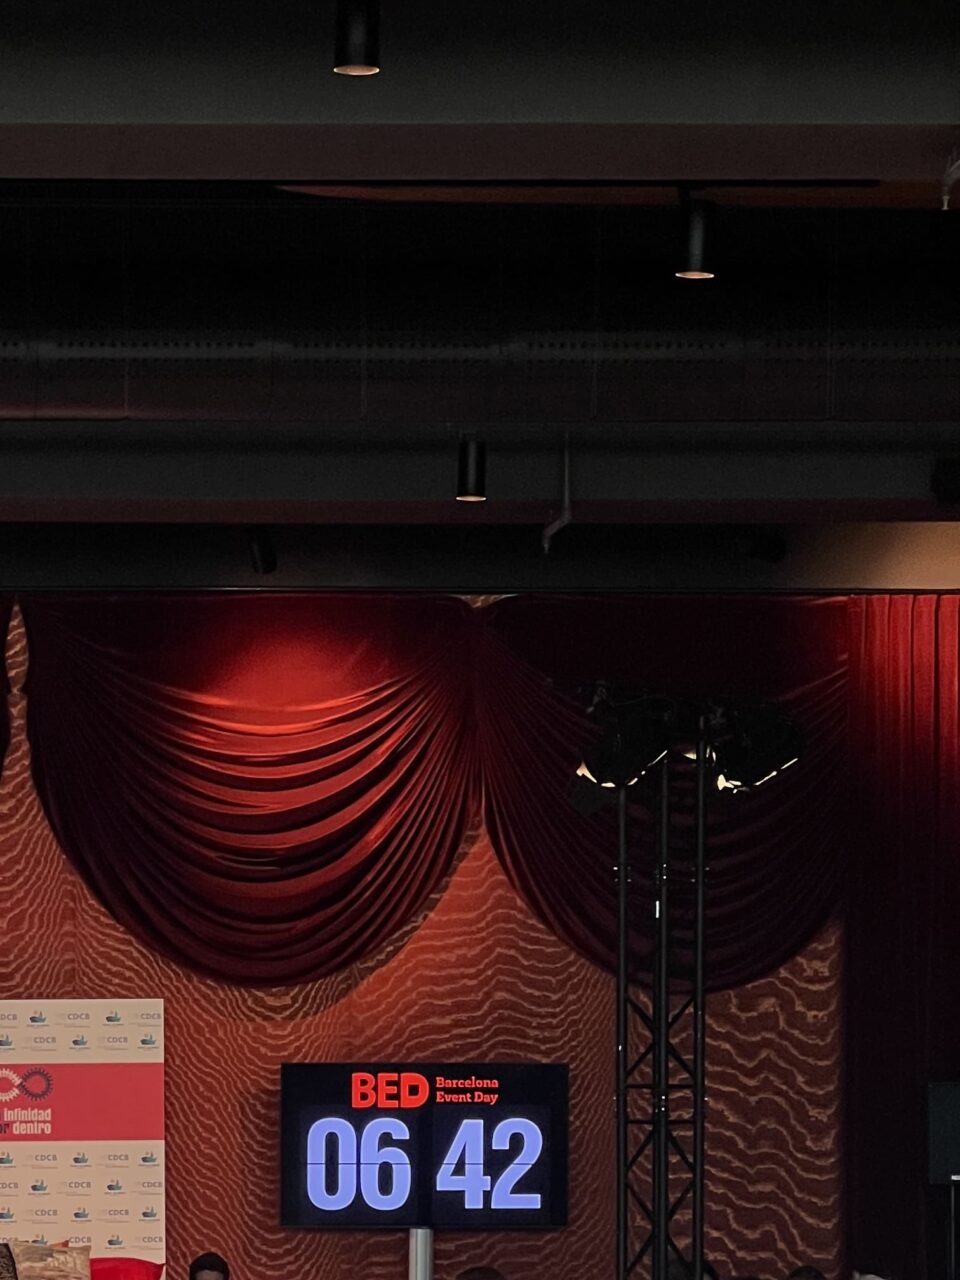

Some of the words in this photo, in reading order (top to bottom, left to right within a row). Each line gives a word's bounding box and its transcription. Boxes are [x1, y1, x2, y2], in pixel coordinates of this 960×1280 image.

[435, 1076, 499, 1088] Barcelona
[351, 1072, 430, 1109] BED
[436, 1091, 472, 1103] Event
[474, 1092, 499, 1105] Day
[3, 1108, 52, 1121] infinidad
[12, 1122, 52, 1135] dentro
[306, 1117, 411, 1211] 06
[436, 1117, 543, 1210] 42
